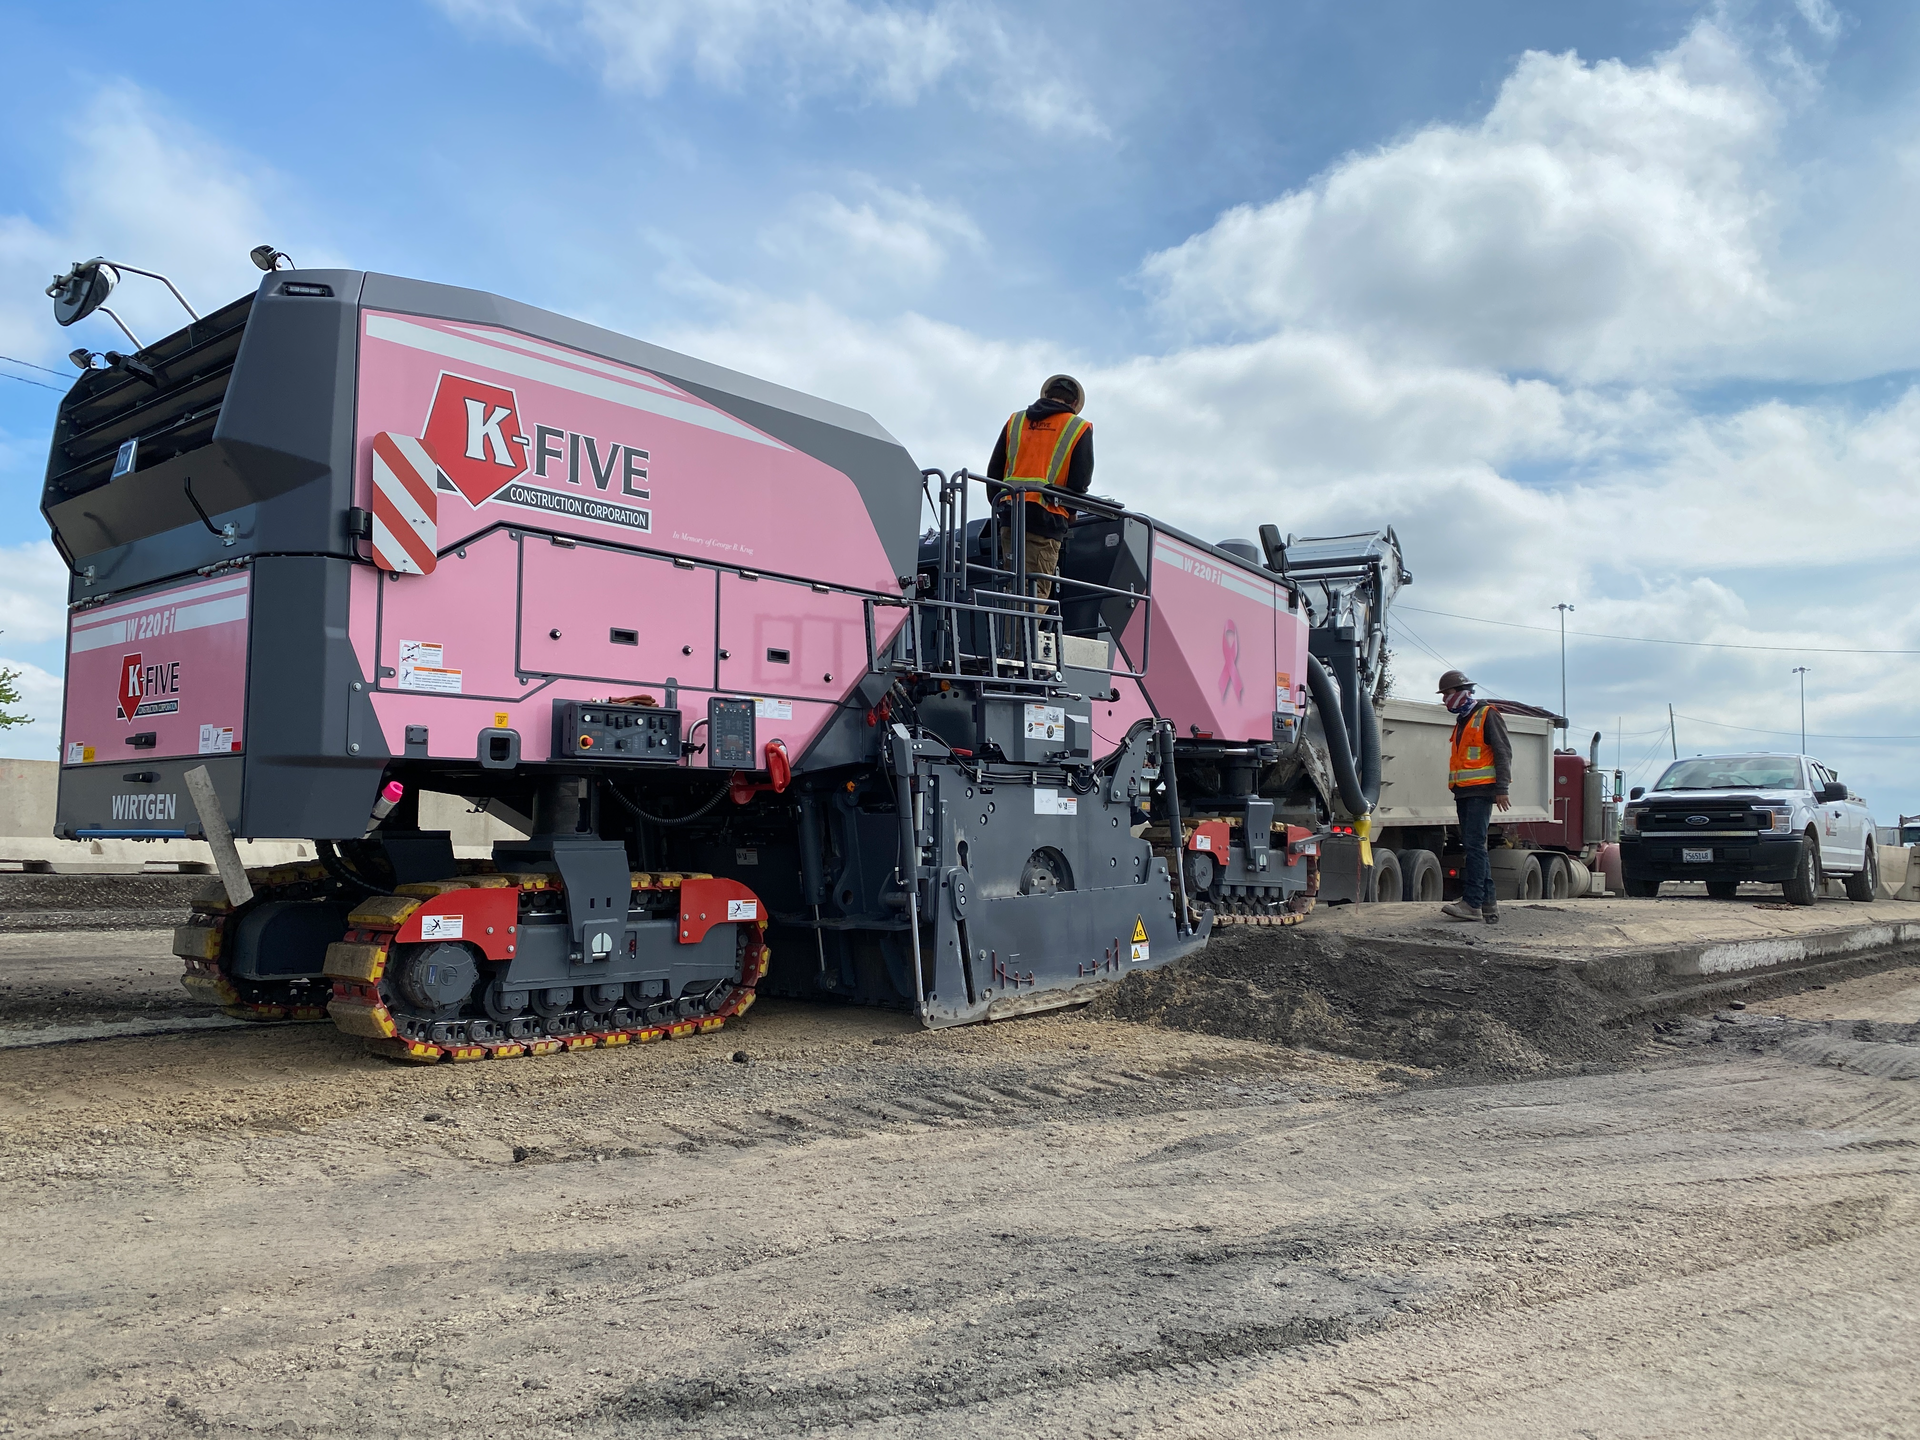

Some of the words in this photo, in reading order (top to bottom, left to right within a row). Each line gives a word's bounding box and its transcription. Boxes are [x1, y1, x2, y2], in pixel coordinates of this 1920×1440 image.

[463, 396, 651, 501] K-FIVE
[510, 487, 582, 514] CONSTRUCTION
[584, 502, 646, 527] CORPORATION
[672, 531, 680, 539] In
[681, 532, 704, 546] Memory
[712, 539, 733, 551] George
[127, 661, 180, 698] K-FIVE
[112, 793, 177, 820] WIRTGEN
